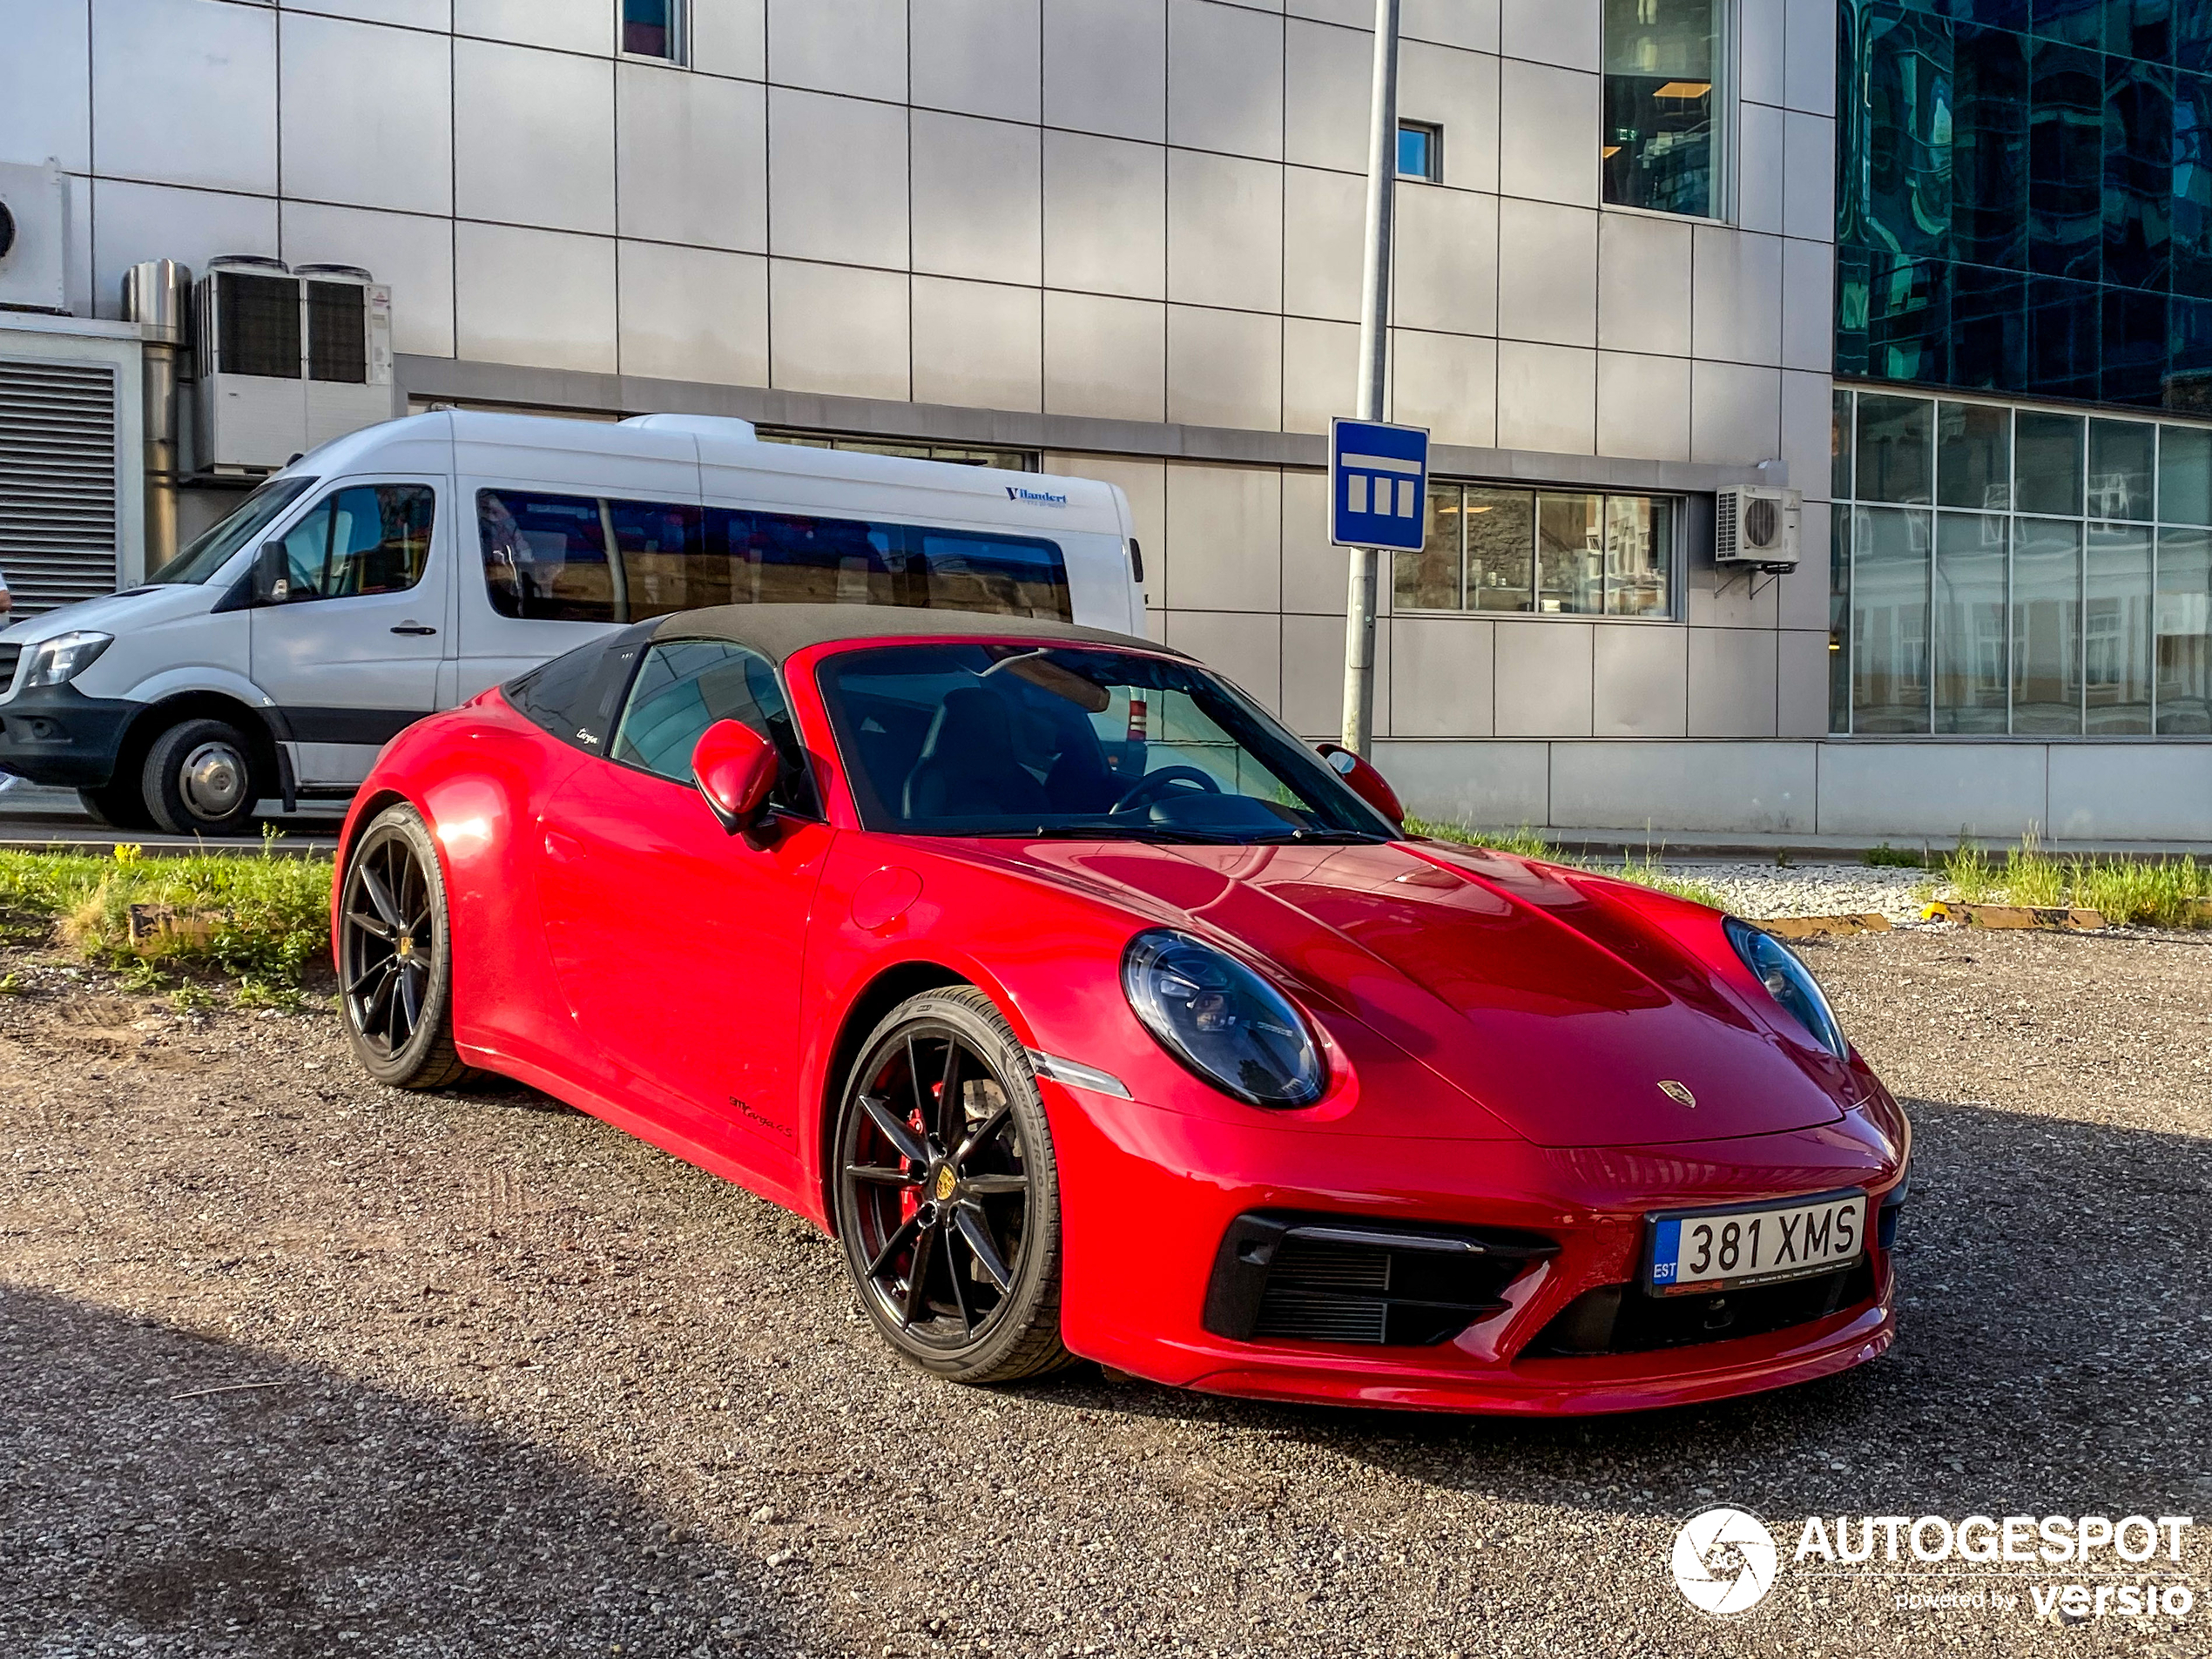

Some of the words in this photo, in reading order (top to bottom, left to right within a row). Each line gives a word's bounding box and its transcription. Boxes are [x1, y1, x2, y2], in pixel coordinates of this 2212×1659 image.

[1689, 1218, 1761, 1274] 381
[1774, 1204, 1856, 1265] XMS
[1654, 1263, 1677, 1278] EST
